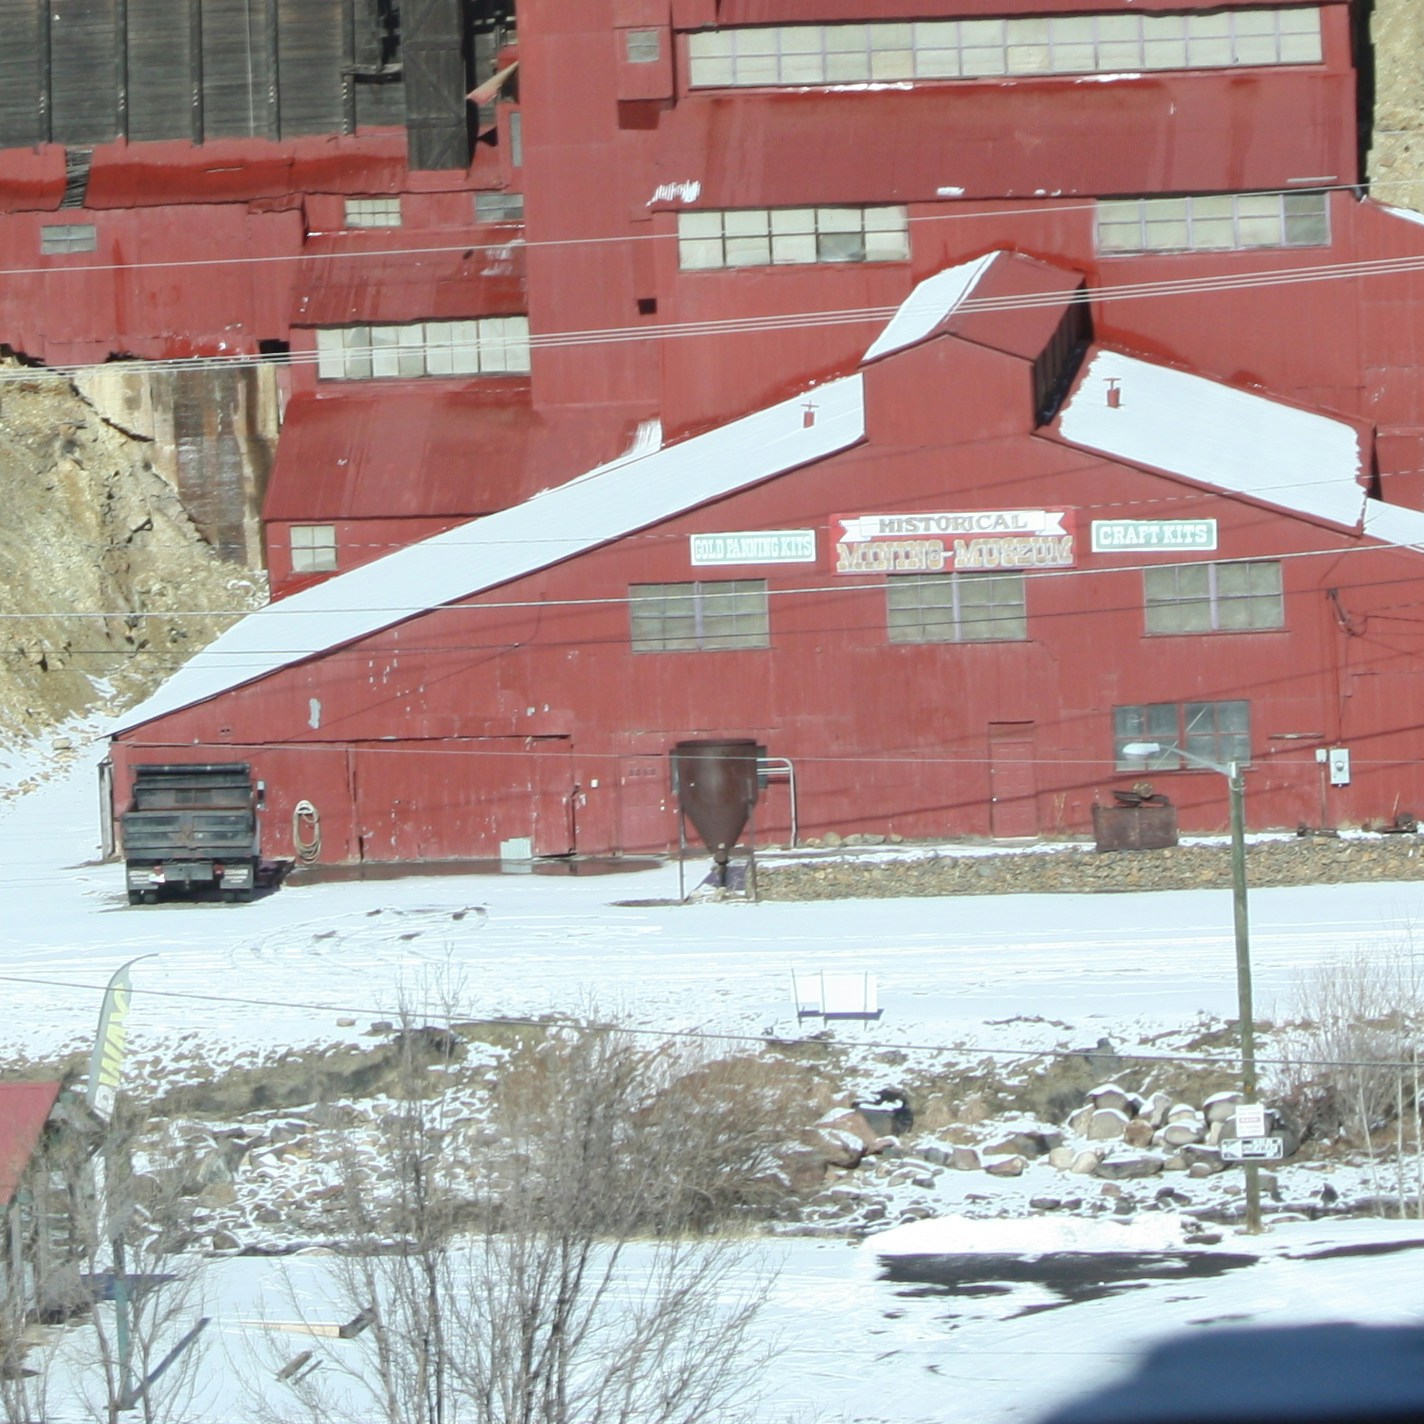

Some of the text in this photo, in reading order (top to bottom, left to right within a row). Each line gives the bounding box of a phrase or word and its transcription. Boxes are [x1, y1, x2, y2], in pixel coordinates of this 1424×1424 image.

[878, 513, 1028, 534] HISTORICAL
[1099, 524, 1208, 545] CRAFT KITS
[694, 538, 726, 560] GOLD
[781, 535, 812, 557] KITS
[836, 535, 1074, 573] MINING MUSEUM
